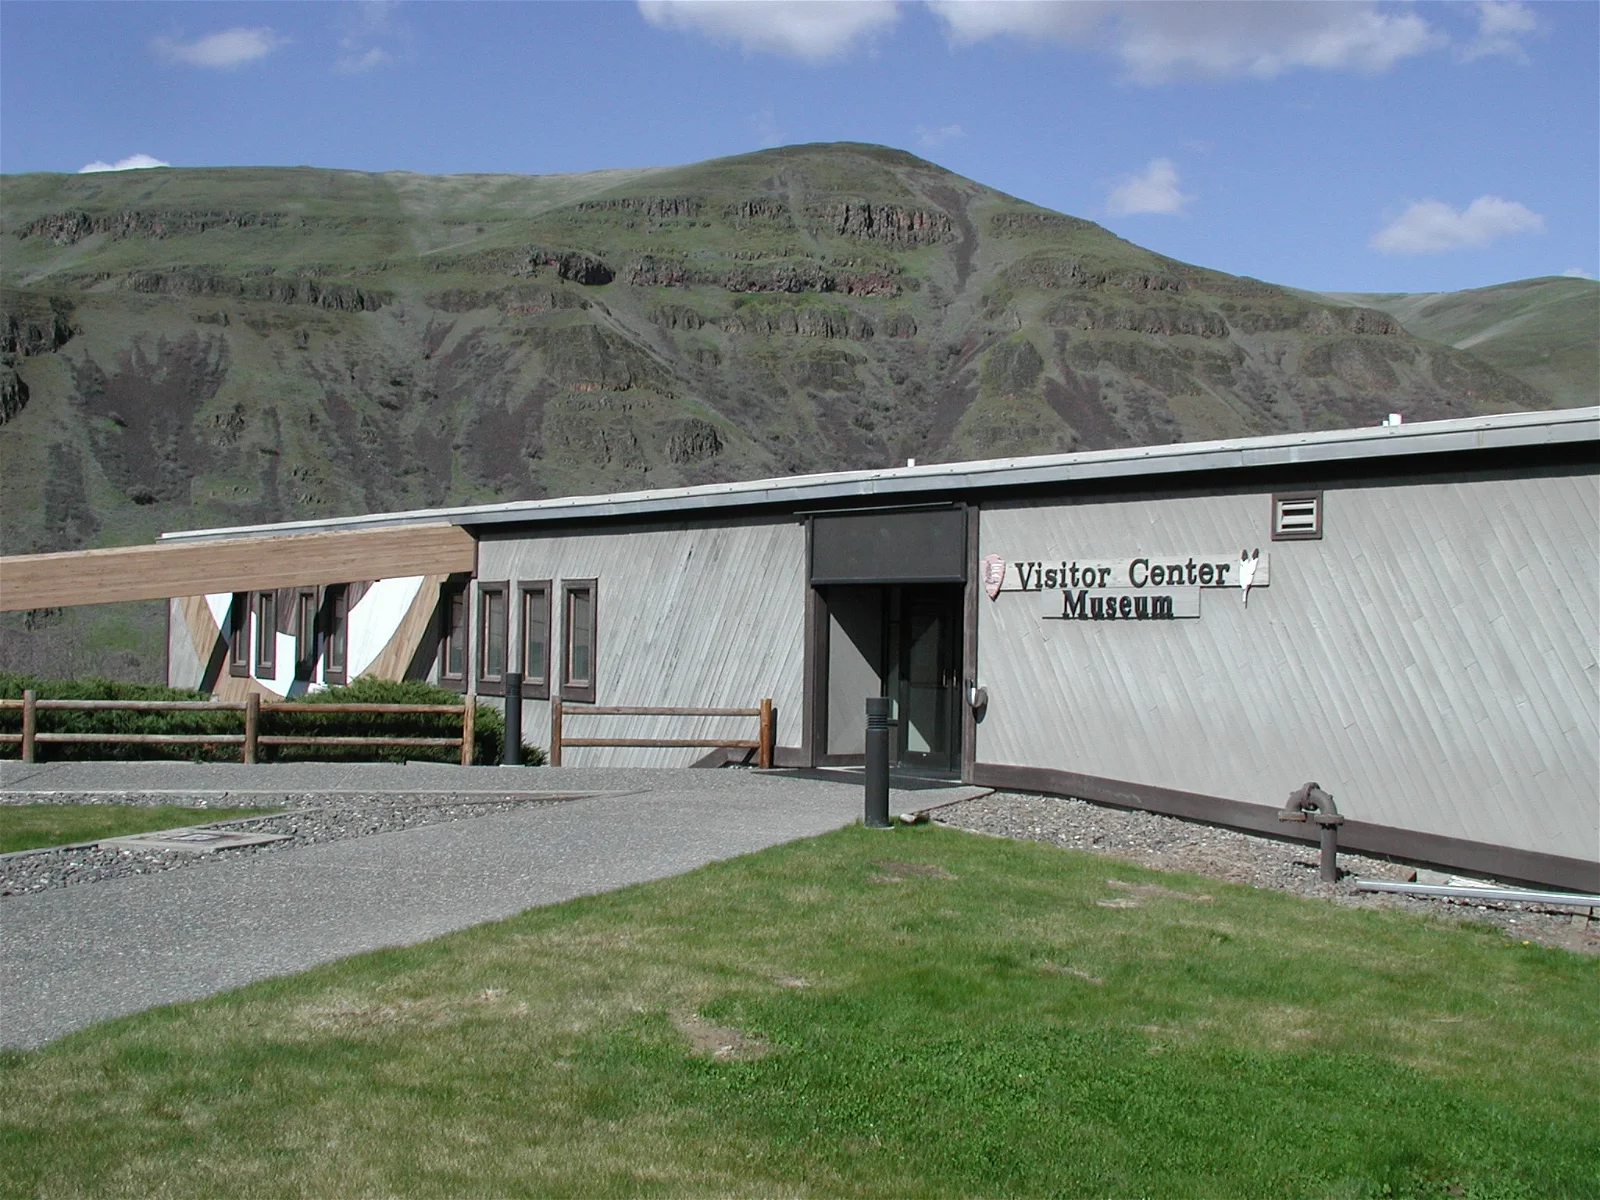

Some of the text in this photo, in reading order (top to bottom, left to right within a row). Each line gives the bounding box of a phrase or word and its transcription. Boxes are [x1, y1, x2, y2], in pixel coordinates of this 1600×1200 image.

[1014, 561, 1111, 590] Visitor
[1129, 557, 1230, 588] Center
[1062, 589, 1174, 620] Museum
